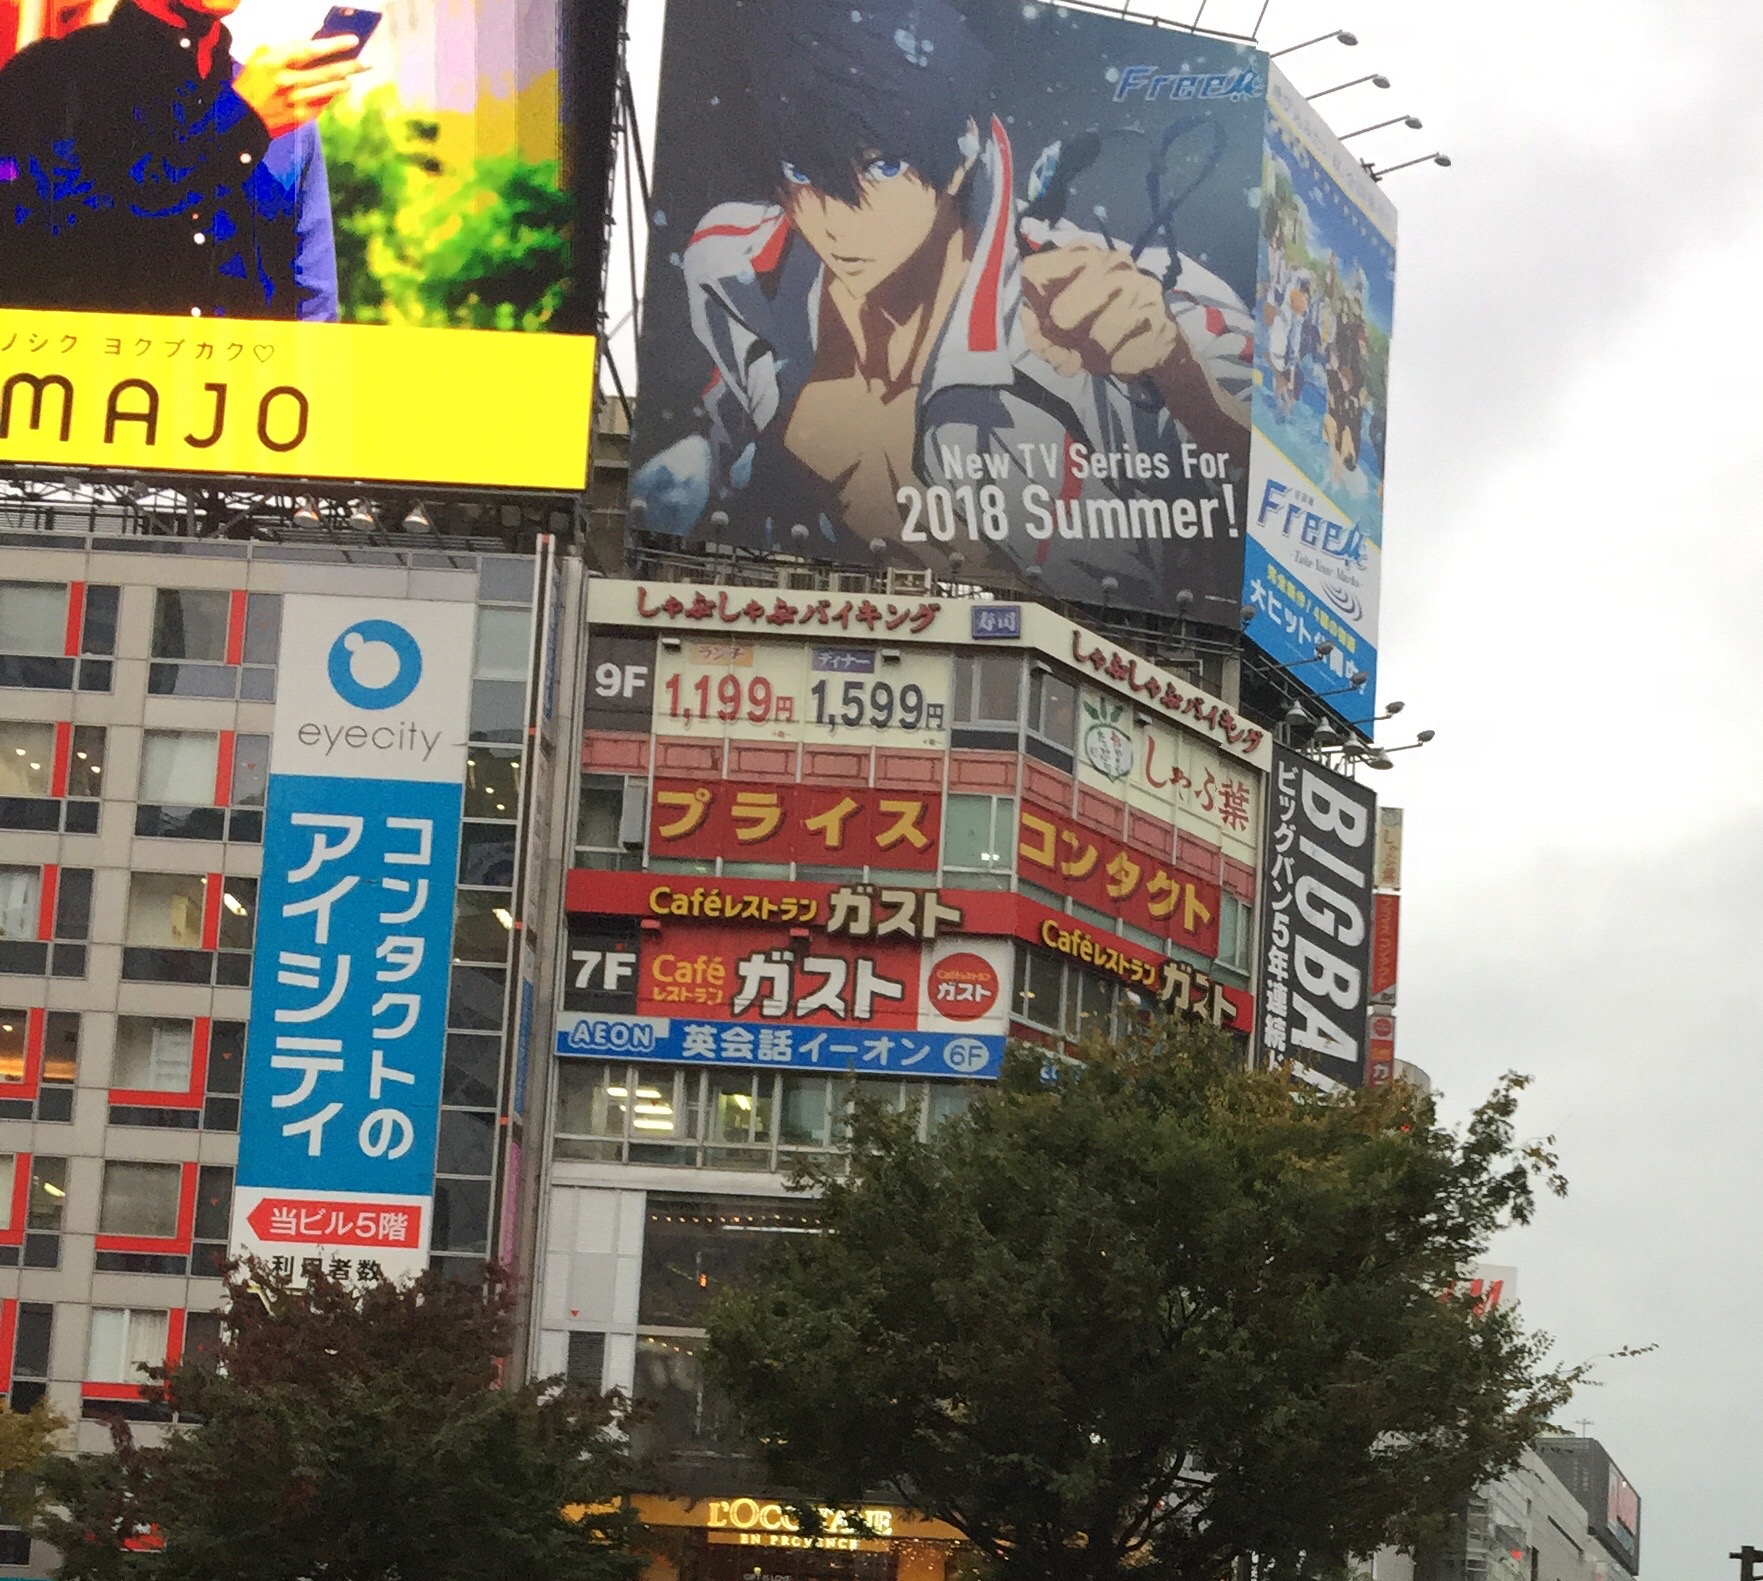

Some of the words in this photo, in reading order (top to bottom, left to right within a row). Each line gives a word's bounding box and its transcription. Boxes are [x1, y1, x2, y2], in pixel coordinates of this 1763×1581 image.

[942, 445, 1011, 479] New
[1020, 446, 1059, 480] TV
[1070, 443, 1171, 481] Series
[1183, 444, 1231, 481] For
[897, 484, 1008, 544] 2018
[1025, 492, 1240, 541] Summer!
[637, 585, 941, 633] しゃぶしゃぶバイキング
[595, 661, 649, 699] 9F
[664, 672, 796, 727] 1,199円
[1072, 629, 1265, 754] しゃぶしゃぶバイキング
[811, 678, 945, 734] 1,599円
[298, 719, 442, 762] eyecity
[656, 787, 934, 850] プライス
[1017, 811, 1216, 937] コンタクト
[648, 885, 818, 923] Caféレストラン
[825, 881, 964, 941] ガスト
[270, 811, 366, 1158] アイシティ
[358, 815, 435, 1162] コンタクトの
[571, 949, 637, 991] 7F
[651, 954, 727, 985] Café
[731, 948, 905, 1020] ガスト
[570, 1020, 656, 1051] AEON
[682, 1024, 932, 1067] 英会話イーオン
[948, 1043, 984, 1067] 6F
[268, 1206, 411, 1244] 当ビル5階
[740, 1533, 763, 1546] EN
